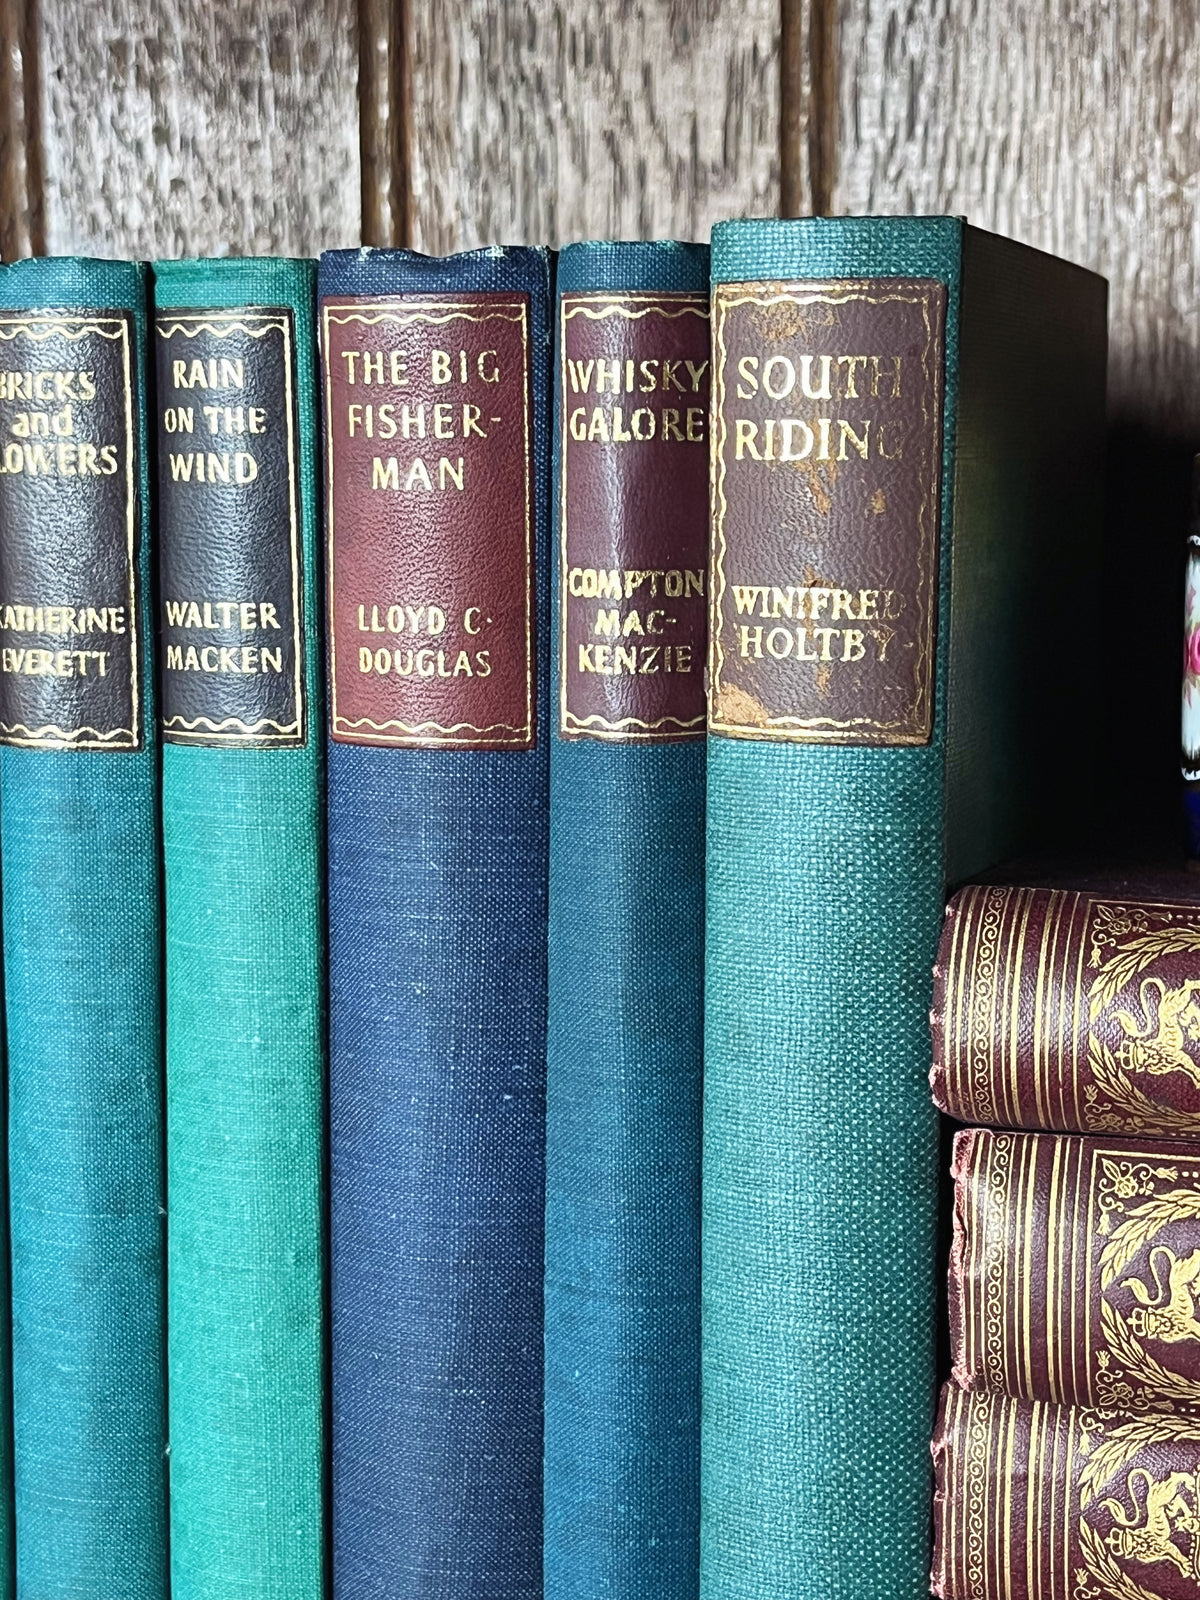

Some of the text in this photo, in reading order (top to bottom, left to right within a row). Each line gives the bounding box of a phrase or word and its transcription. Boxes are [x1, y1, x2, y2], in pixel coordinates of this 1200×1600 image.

[173, 359, 245, 389] RAIN
[342, 350, 500, 384] THE BIG
[567, 358, 708, 394] WHISKY
[736, 355, 902, 400] SOUTH
[12, 403, 73, 438] and
[164, 406, 266, 434] ON THE
[348, 404, 501, 439] FISHER-
[569, 406, 704, 442] GALORE
[169, 452, 258, 484] WIND
[371, 456, 465, 491] MAN
[569, 567, 705, 600] COMPTON
[165, 602, 281, 630] WALTER
[358, 605, 446, 635] LLOYD
[594, 609, 677, 637] MAC-
[166, 645, 282, 674] MACKEN
[579, 643, 692, 675] KENZIE
[740, 625, 897, 662] HOLTBY
[2, 648, 110, 677] EVERETT
[358, 647, 491, 678] DOUGLAS
